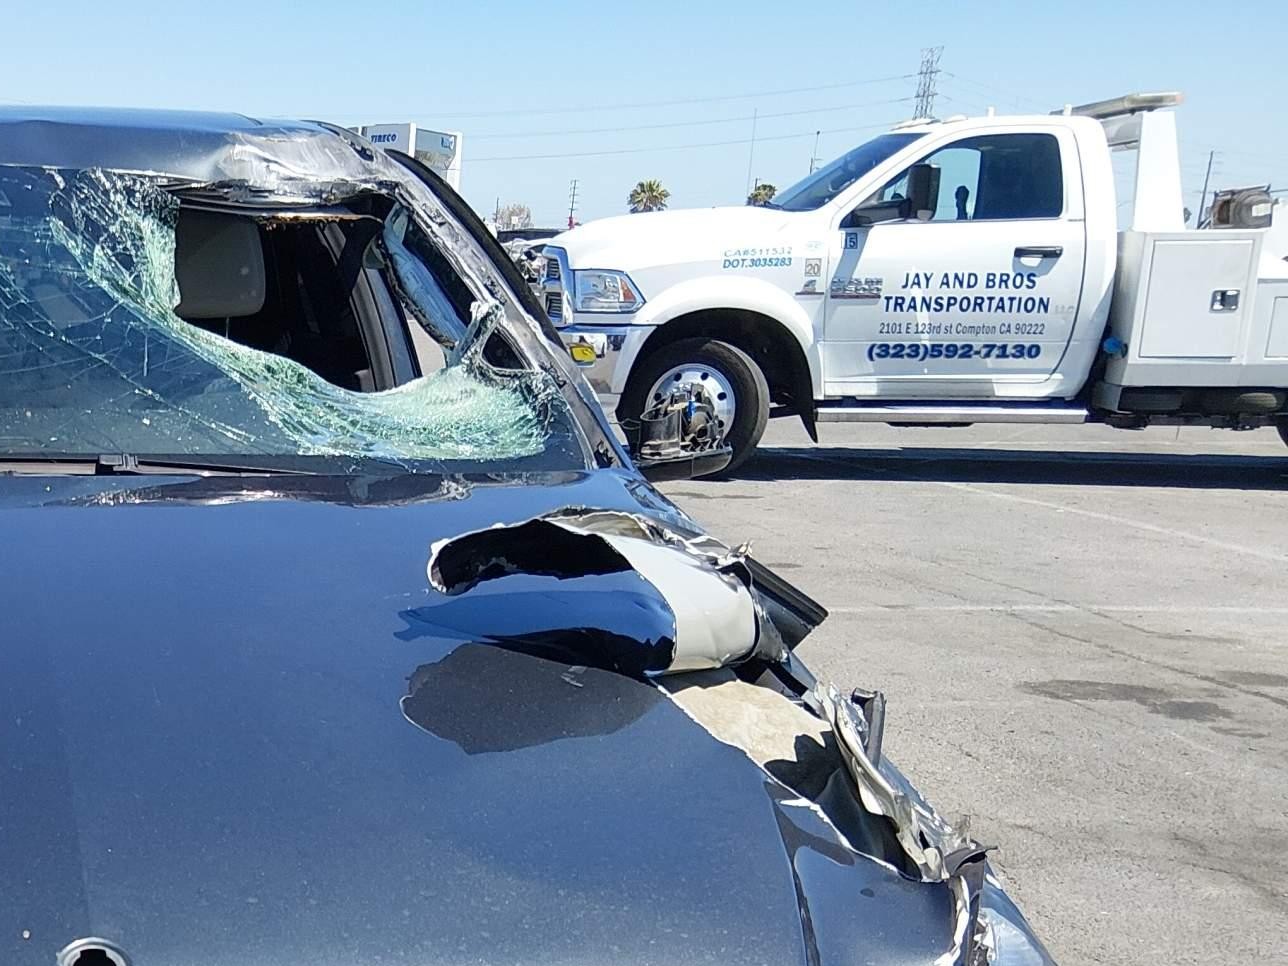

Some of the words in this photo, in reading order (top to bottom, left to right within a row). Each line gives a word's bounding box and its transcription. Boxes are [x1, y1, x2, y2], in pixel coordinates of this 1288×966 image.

[371, 133, 397, 143] TIRECO
[722, 257, 793, 269] DOT.3035283
[805, 263, 820, 275] 20
[901, 272, 934, 289] JAY
[939, 272, 979, 289] AND
[985, 272, 1037, 290] BROS
[883, 296, 1051, 314] TRANSPORTATION
[879, 322, 903, 335] 2101
[905, 322, 912, 335] E
[913, 322, 942, 335] 123rd
[944, 323, 953, 335] st
[955, 322, 997, 337] Compton
[999, 323, 1012, 335] CA
[1014, 323, 1046, 336] 90222
[867, 343, 1042, 361] (323)592-7130
